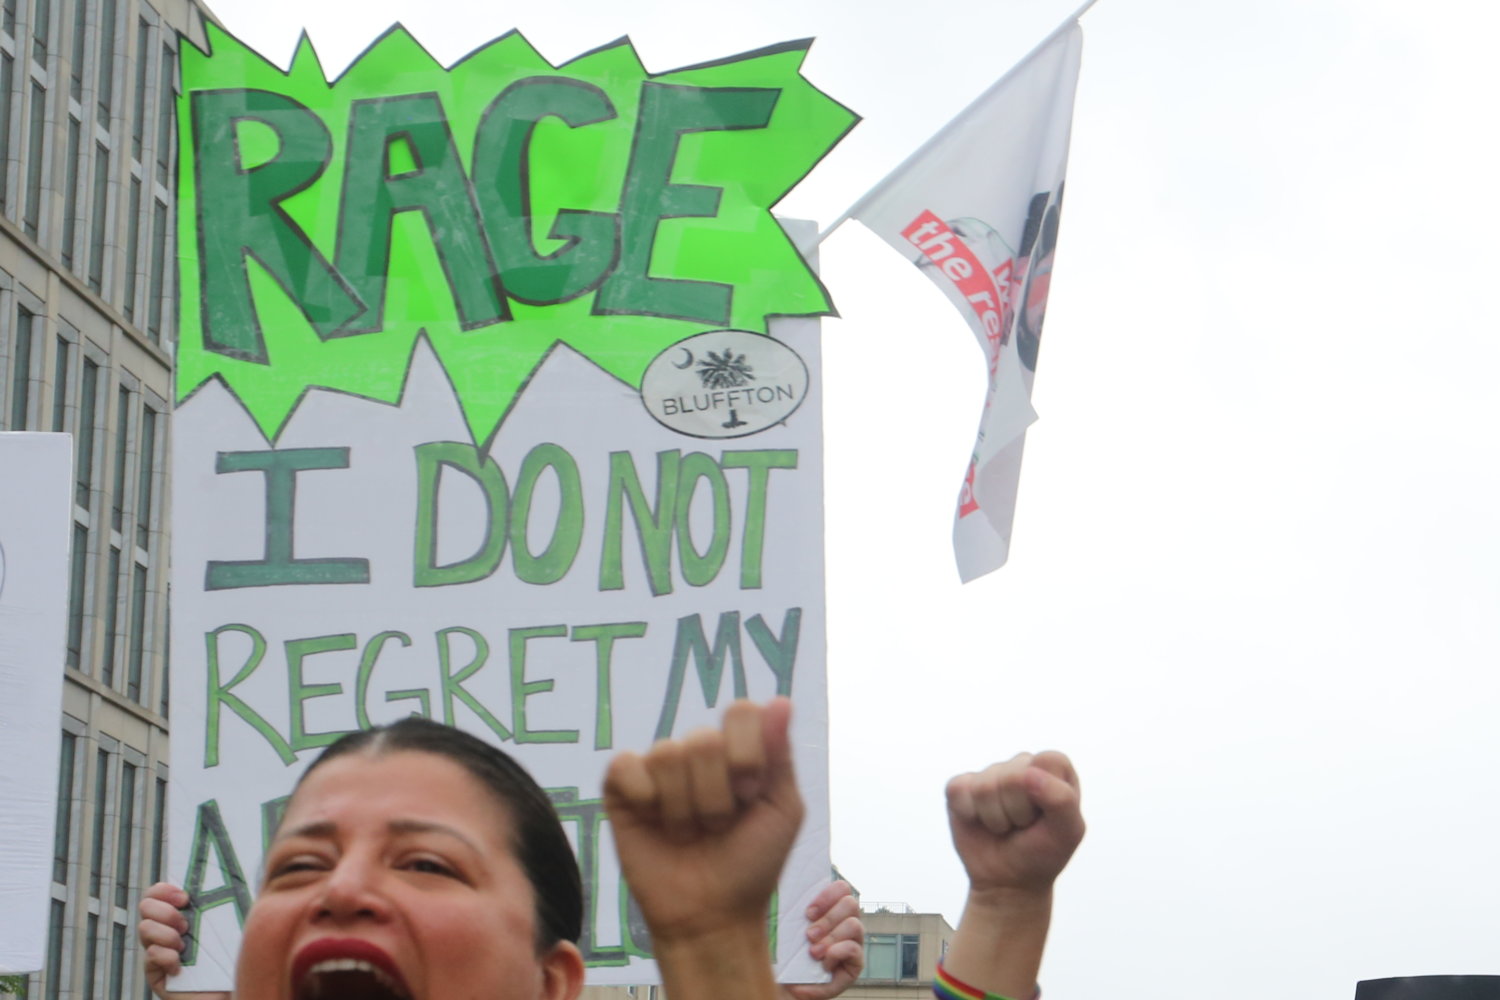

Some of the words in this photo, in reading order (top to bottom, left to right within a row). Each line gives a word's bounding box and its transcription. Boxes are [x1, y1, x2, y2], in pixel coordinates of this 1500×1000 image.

[191, 76, 783, 365] RAGE
[907, 220, 973, 283] the
[662, 384, 794, 416] BLUFFTON
[205, 446, 371, 591] I
[413, 441, 585, 588] DO
[600, 447, 799, 597] NOT
[204, 622, 648, 768] REGRET
[653, 606, 802, 742] MY
